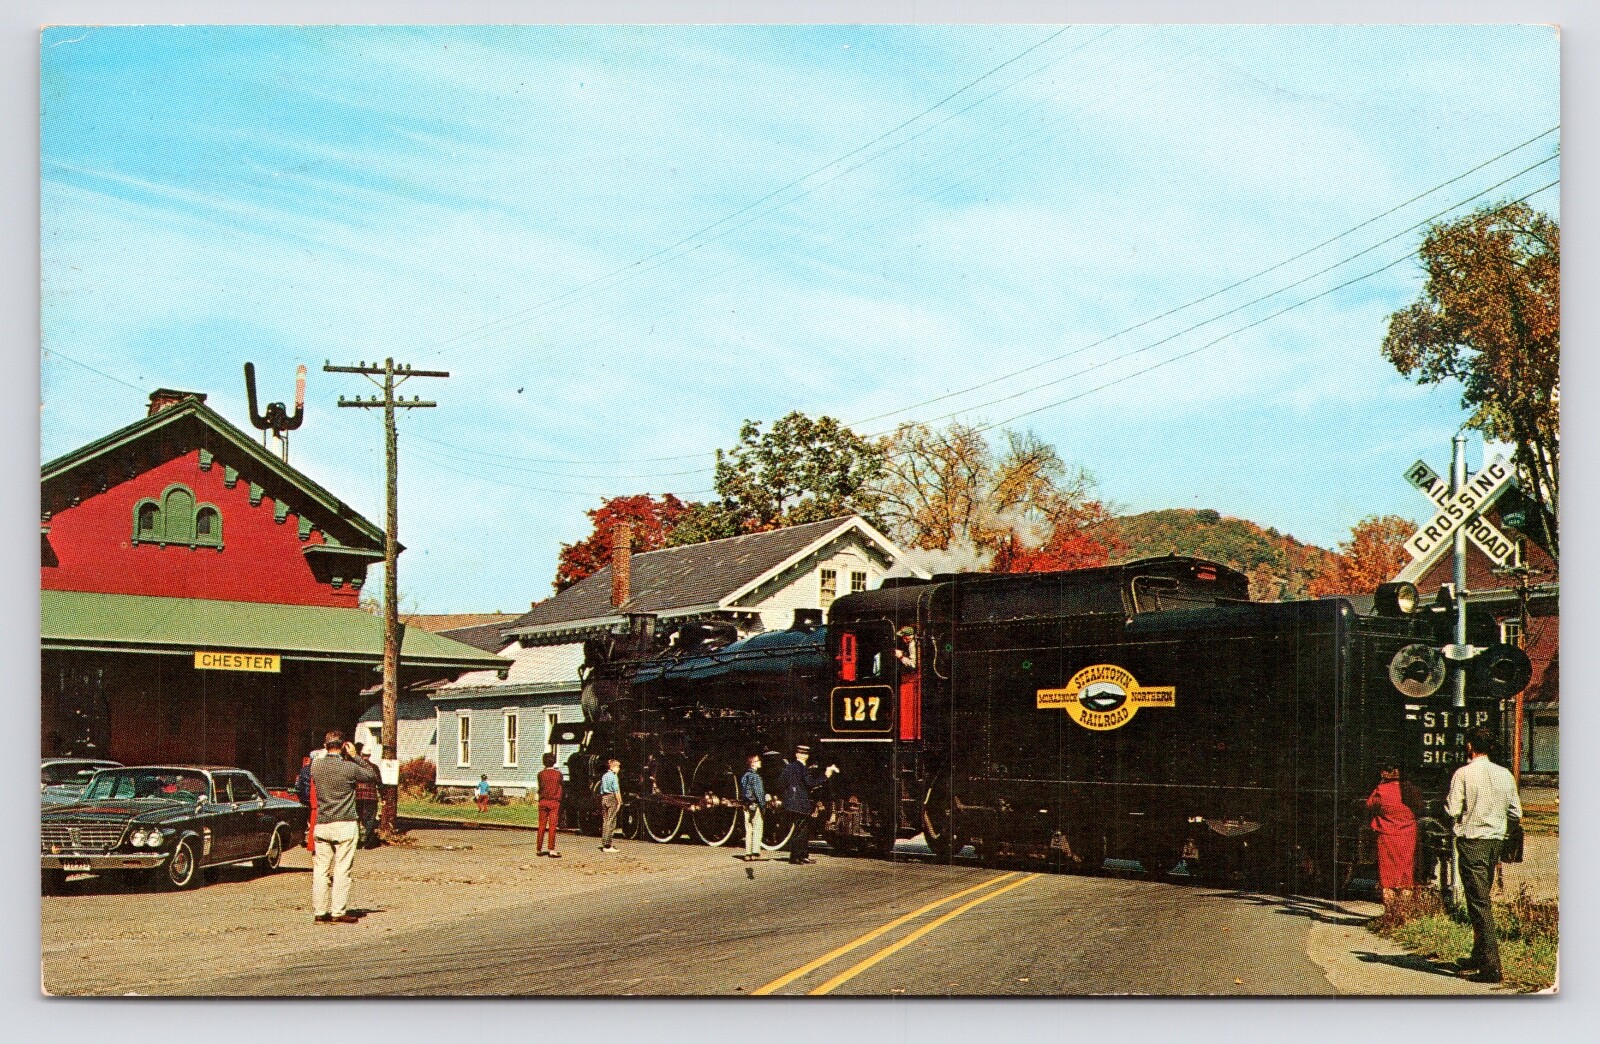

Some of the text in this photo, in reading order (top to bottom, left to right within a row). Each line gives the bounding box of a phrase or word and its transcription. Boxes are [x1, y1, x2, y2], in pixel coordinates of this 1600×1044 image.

[1410, 466, 1509, 559] RAIL ROAD
[1413, 463, 1506, 553] CROSSING
[202, 654, 273, 669] CHESTER
[1074, 667, 1132, 689] STEAMTOWN
[1131, 691, 1173, 702] NORTHERN
[843, 696, 880, 721] 127
[1080, 708, 1128, 727] RAILROAD
[1423, 711, 1489, 728] STOP
[1423, 733, 1445, 746] ON
